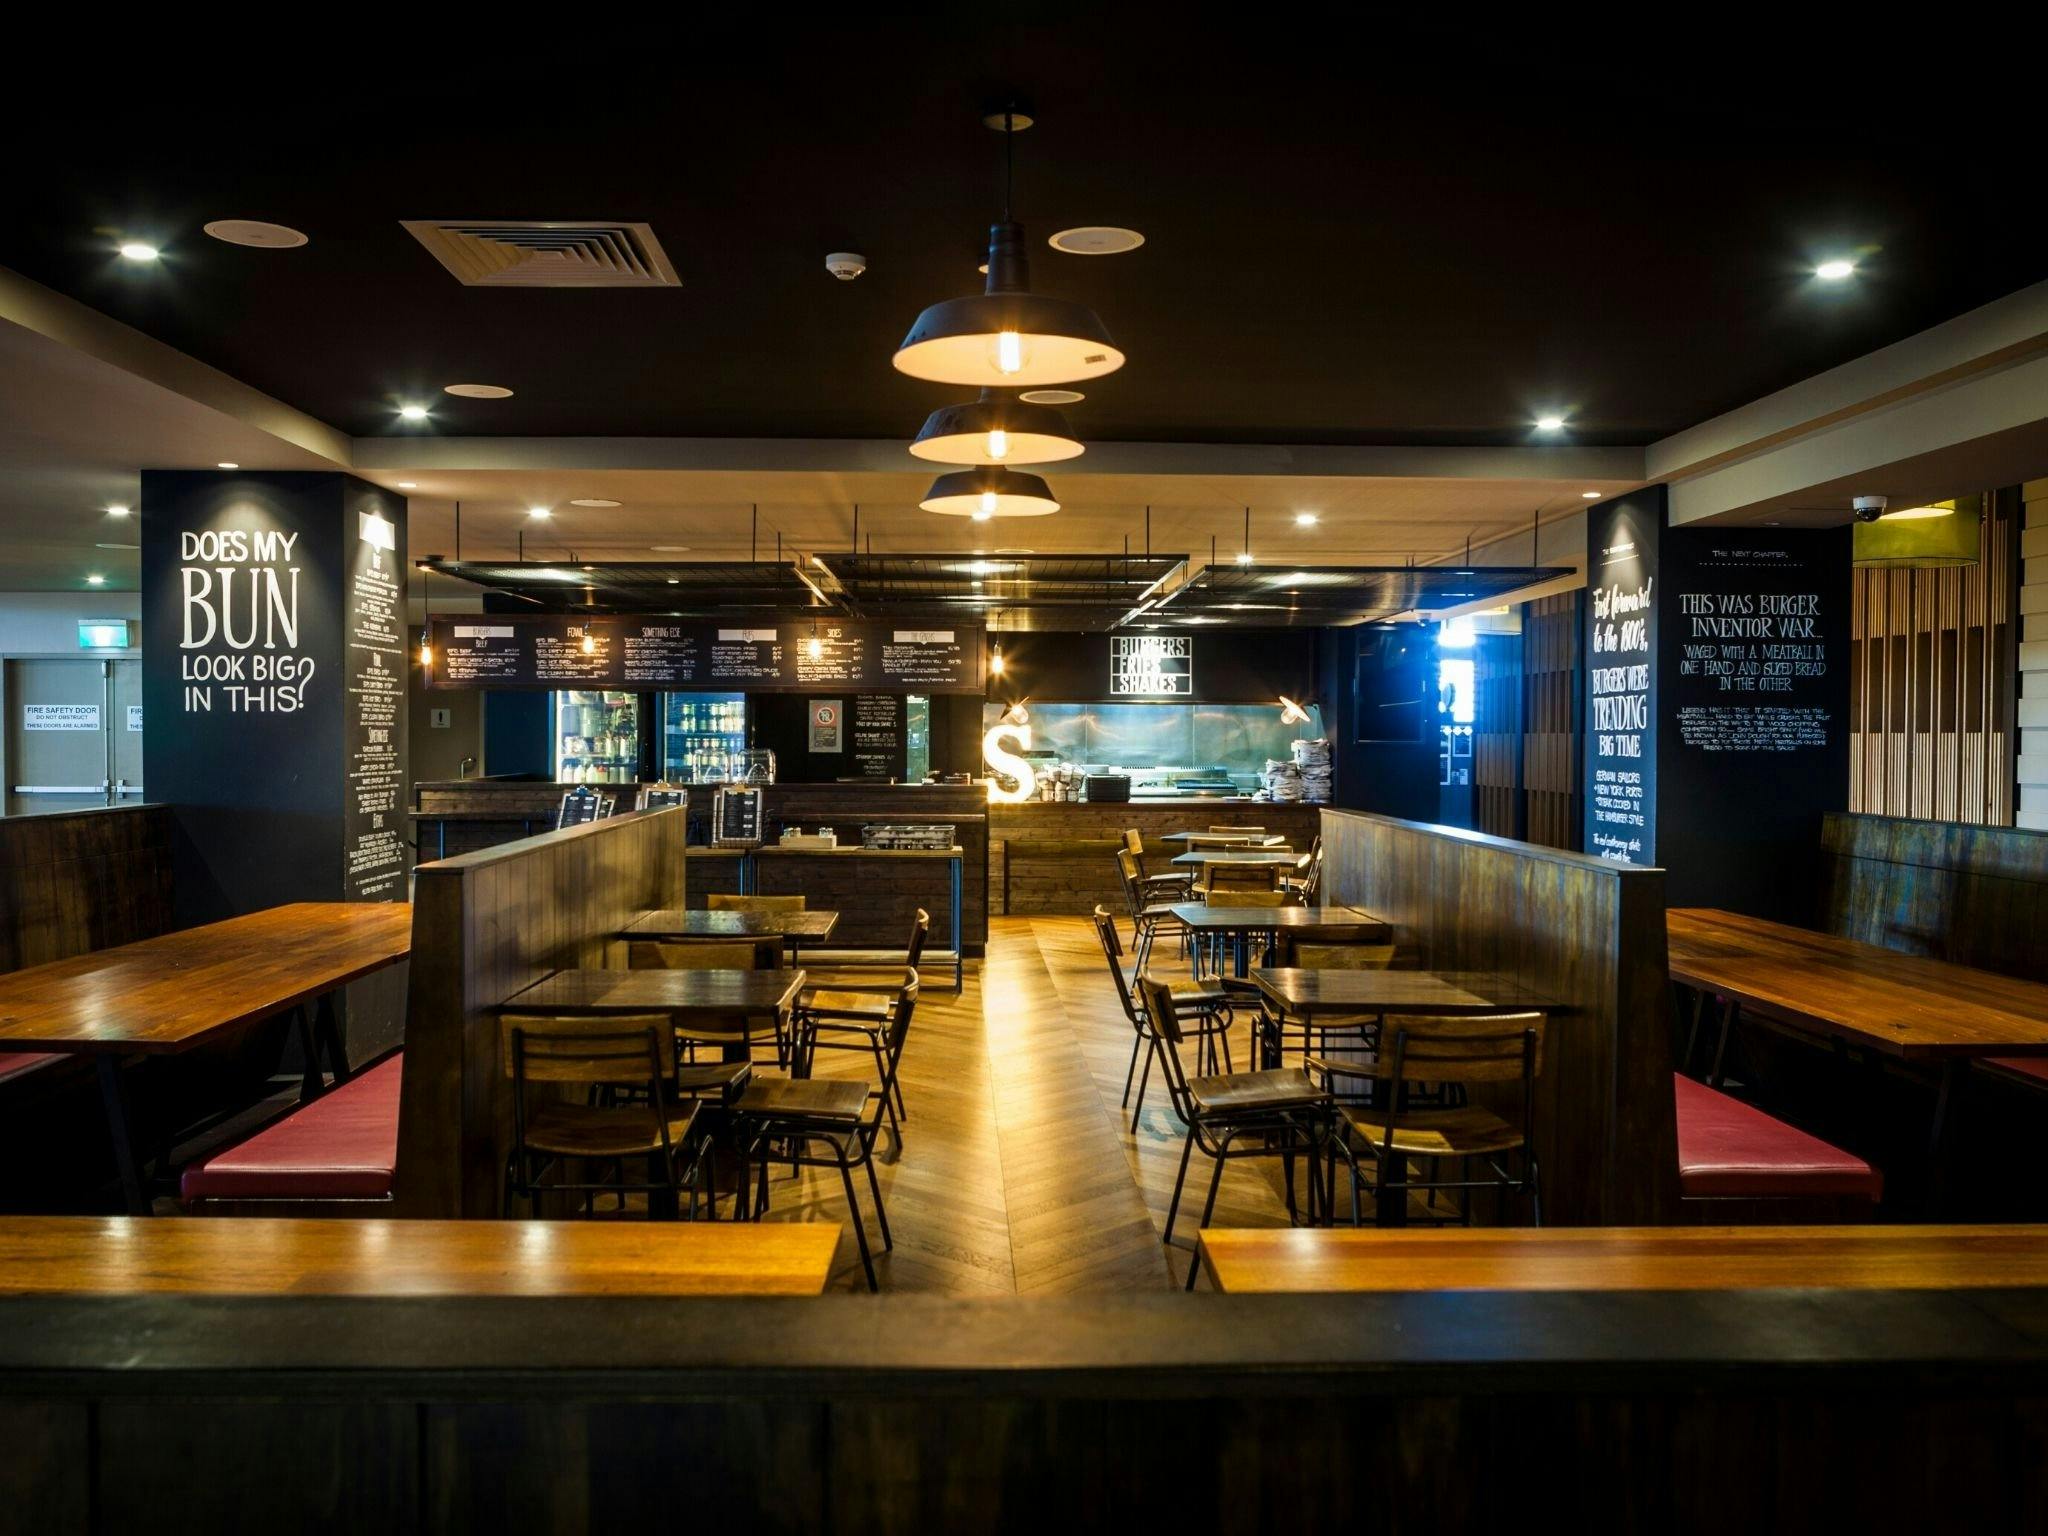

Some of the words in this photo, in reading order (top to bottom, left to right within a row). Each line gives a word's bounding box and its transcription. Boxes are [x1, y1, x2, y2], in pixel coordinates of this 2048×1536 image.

[182, 531, 248, 562] DOES
[254, 531, 298, 562] MY
[1712, 550, 1728, 558] THE
[1732, 550, 1751, 558] NEXT
[180, 567, 301, 650] BUN
[1611, 576, 1653, 620] forward
[1679, 594, 1714, 614] THIS
[1716, 594, 1754, 614] WAS
[1759, 595, 1821, 616] BURGER
[642, 627, 669, 638] SOMETHING
[670, 627, 681, 638] ELSE
[1593, 623, 1603, 652] to
[1604, 623, 1618, 652] the
[1692, 617, 1775, 638] INVENTOR
[1120, 638, 1185, 656] BURGERS
[1682, 644, 1718, 659] WAGED
[1721, 644, 1745, 659] WITH
[1749, 644, 1757, 659] A
[1762, 644, 1813, 660] MEATBALL
[1815, 644, 1825, 660] IN
[182, 655, 246, 681] LOOK
[1120, 656, 1161, 674] FRIES
[1680, 661, 1700, 675] ONE
[1704, 661, 1735, 676] HAND
[1738, 661, 1761, 676] AND
[1763, 662, 1793, 676] SLICED
[1795, 662, 1827, 676] BREAD
[1120, 674, 1177, 692] SHAKES
[1592, 666, 1626, 694] BURGERS
[1626, 664, 1649, 691] WERE
[1719, 677, 1731, 691] IN
[1734, 677, 1755, 691] THE
[1759, 677, 1793, 691] OTHER
[185, 686, 211, 712] IN
[1593, 695, 1647, 730] TRENDING
[1599, 735, 1615, 756] BIG
[1615, 735, 1641, 757] TIME
[983, 724, 1035, 804] S
[1609, 785, 1624, 797] YORK
[1625, 786, 1643, 798] PORTS
[1595, 810, 1605, 821] THE
[1633, 800, 1640, 812] IN
